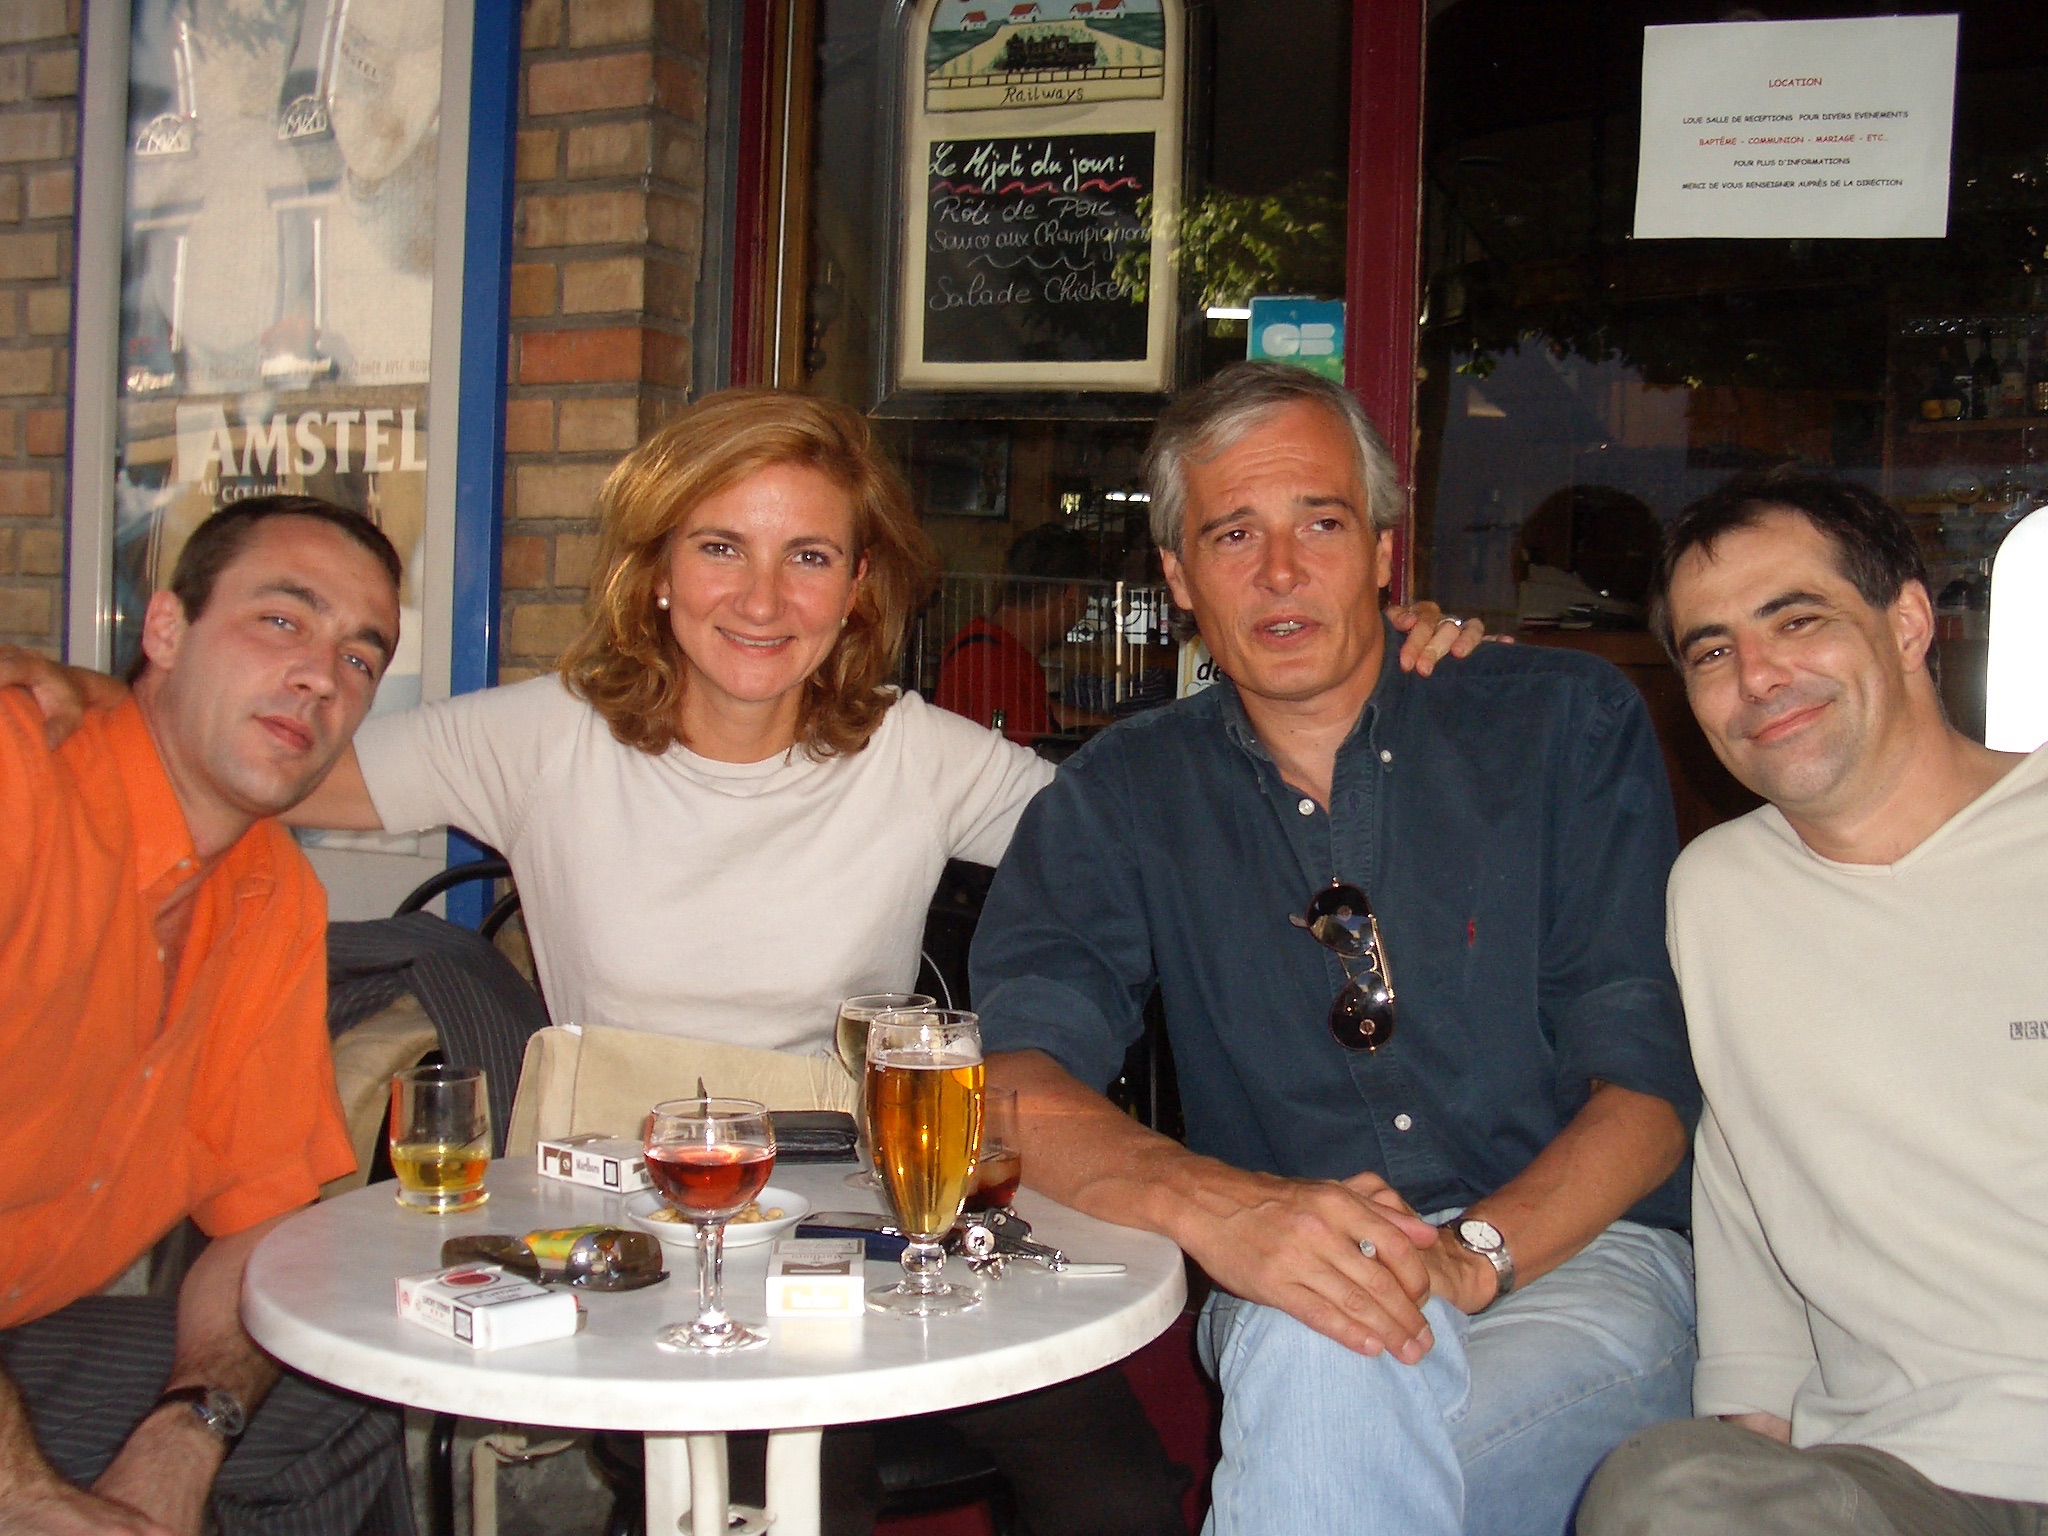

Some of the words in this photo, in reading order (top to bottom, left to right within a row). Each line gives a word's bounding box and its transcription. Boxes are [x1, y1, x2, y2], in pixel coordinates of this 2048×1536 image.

[1767, 77, 1823, 88] LOCATION
[1000, 86, 1084, 105] Railways
[1682, 116, 1703, 125] LOUE
[1706, 115, 1730, 124] SALLE
[1731, 115, 1742, 123] DE
[1744, 114, 1794, 123] RECEPTIONS
[1799, 113, 1820, 121] POUR
[1822, 112, 1852, 121] DIVERS
[1854, 110, 1909, 120] EVENEMENTS
[1699, 136, 1738, 146] BAPTÊME
[1748, 136, 1804, 145] COMMUNION
[1815, 134, 1855, 144] MARIAGE
[928, 142, 957, 178] Le
[1030, 142, 1063, 178] du
[1733, 159, 1754, 167] POUR
[1757, 159, 1776, 167] PLUS
[1778, 158, 1851, 167] D'INFORMATIONS
[1682, 181, 1707, 190] MERCI
[1709, 181, 1719, 189] DE
[1722, 181, 1744, 189] VOUS
[1745, 180, 1795, 189] RENSEIGNER
[1830, 180, 1841, 188] DE
[1843, 180, 1854, 188] LA
[1856, 179, 1903, 188] DIRECTION
[933, 195, 990, 226] Rôti
[1002, 199, 1040, 222] de
[995, 231, 1030, 248] aux
[929, 272, 1032, 311] Salade
[180, 402, 427, 483] AMSTEL
